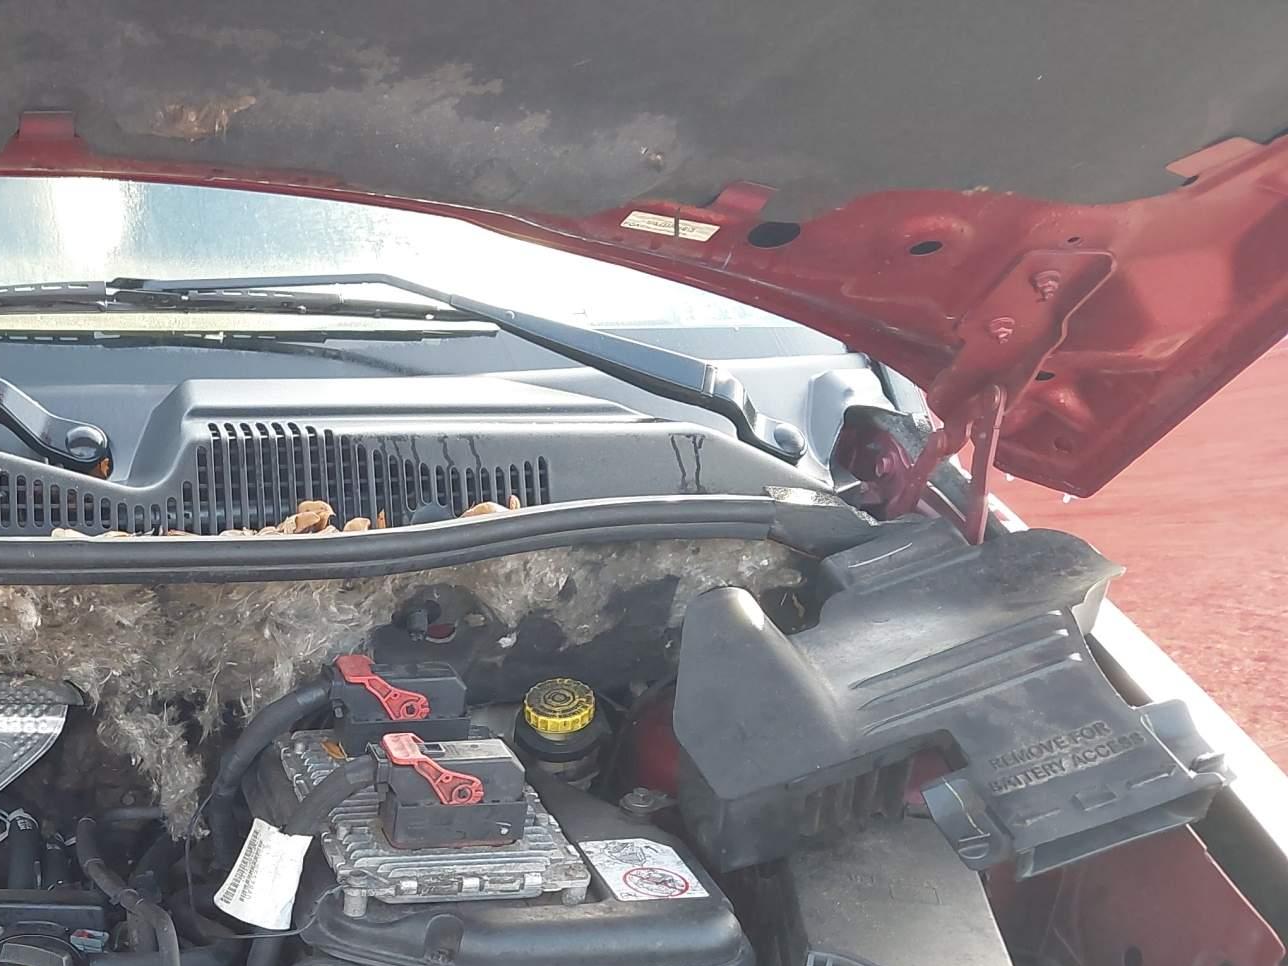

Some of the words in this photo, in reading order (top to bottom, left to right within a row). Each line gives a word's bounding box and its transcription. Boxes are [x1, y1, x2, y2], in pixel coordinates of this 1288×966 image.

[989, 736, 1066, 770] REMOVE
[1070, 721, 1112, 744] FOR
[989, 758, 1066, 792] BATTERY
[1071, 732, 1144, 768] ACCESS
